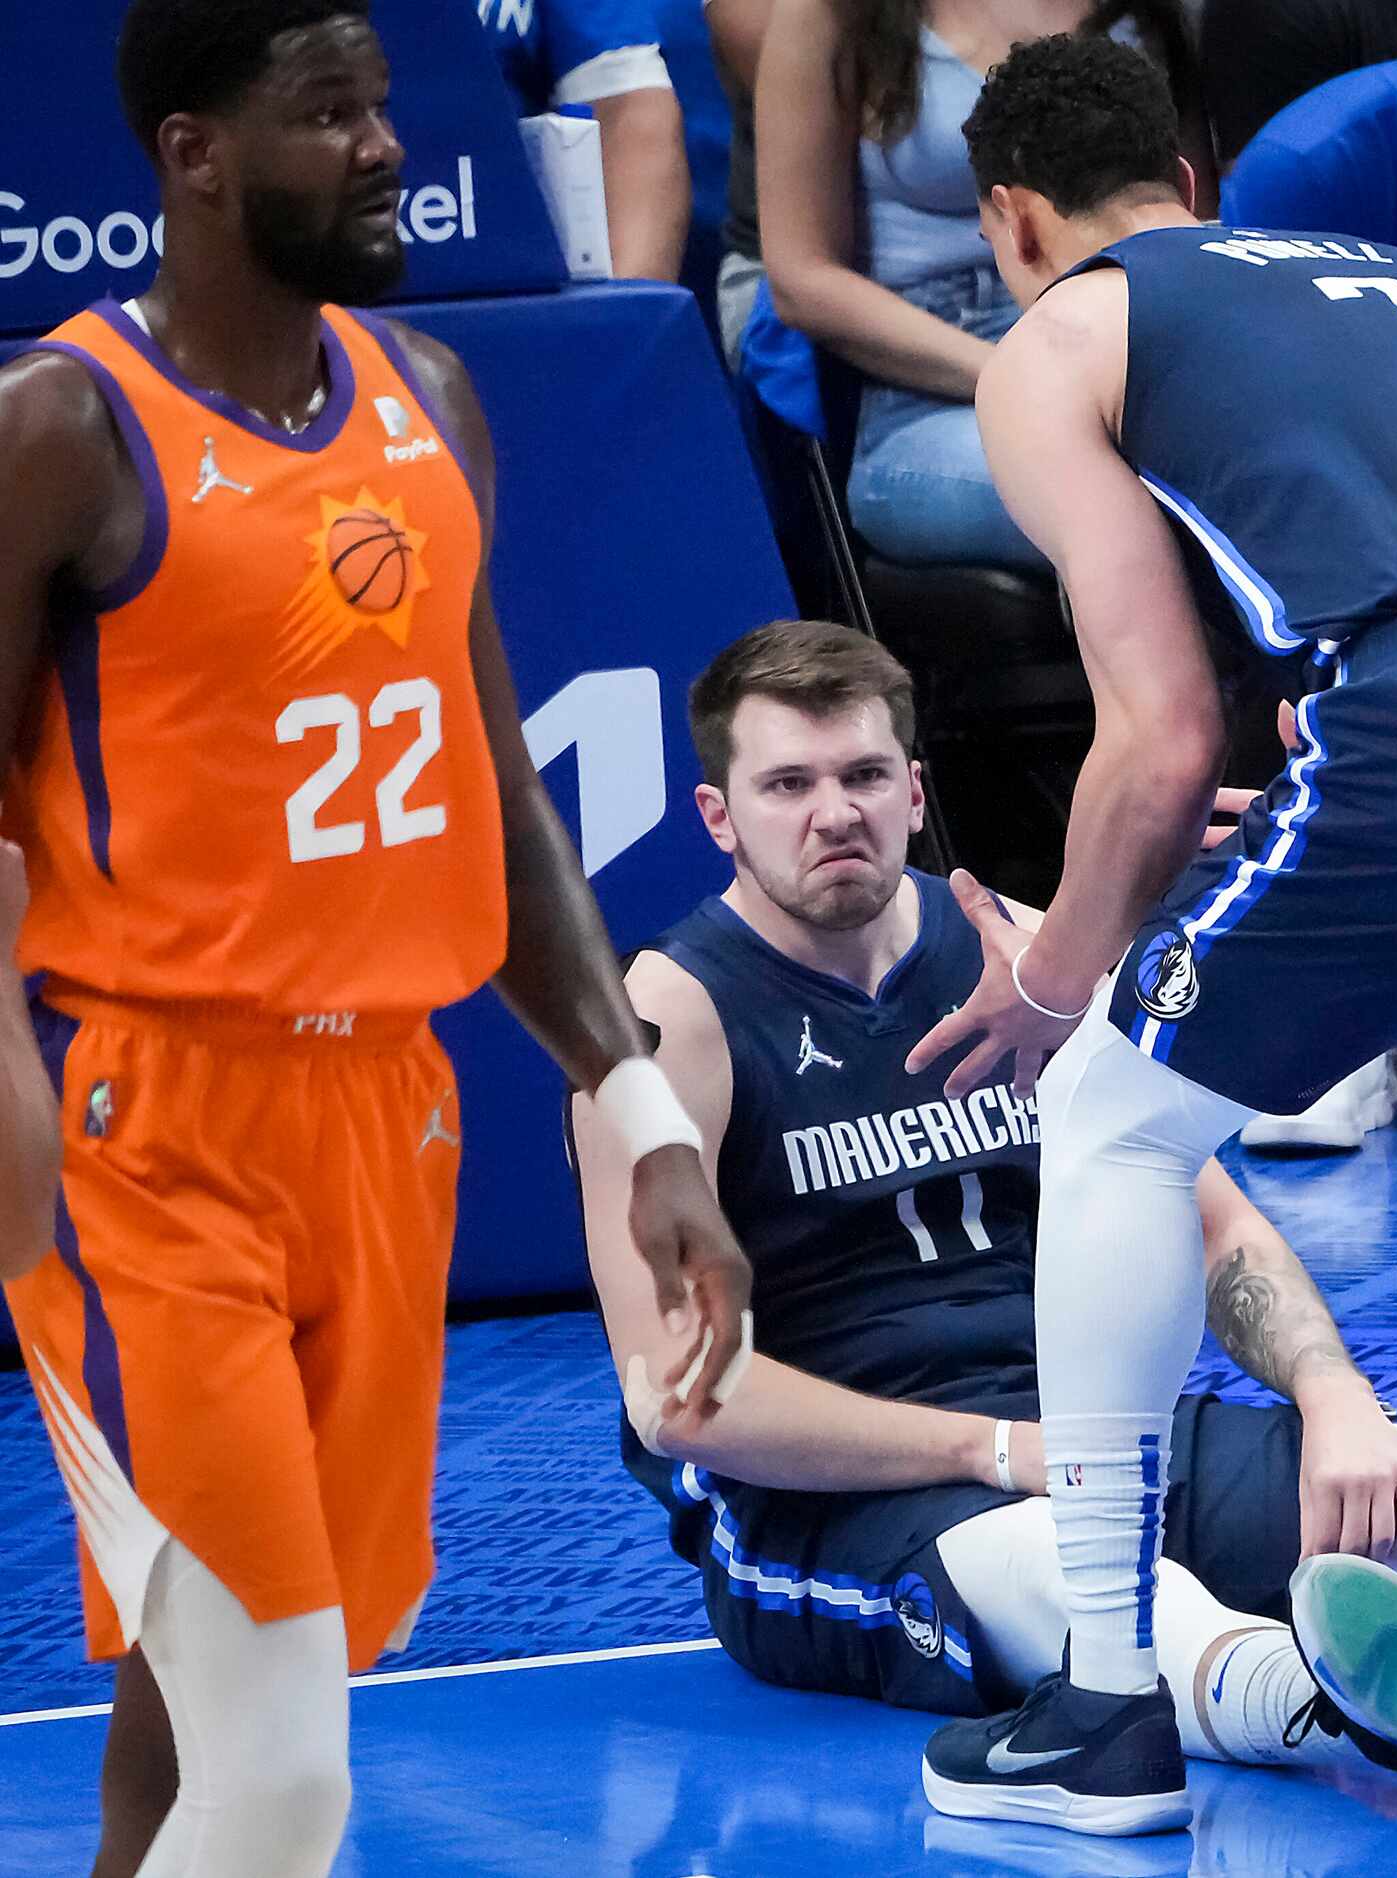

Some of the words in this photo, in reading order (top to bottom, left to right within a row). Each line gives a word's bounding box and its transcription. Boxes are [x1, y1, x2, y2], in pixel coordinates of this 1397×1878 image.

[0, 190, 165, 278] Goo
[1199, 237, 1394, 267] POWELL
[384, 437, 439, 464] PayPal
[276, 677, 446, 863] 22
[293, 1013, 357, 1038] PHX
[896, 1172, 992, 1262] 11
